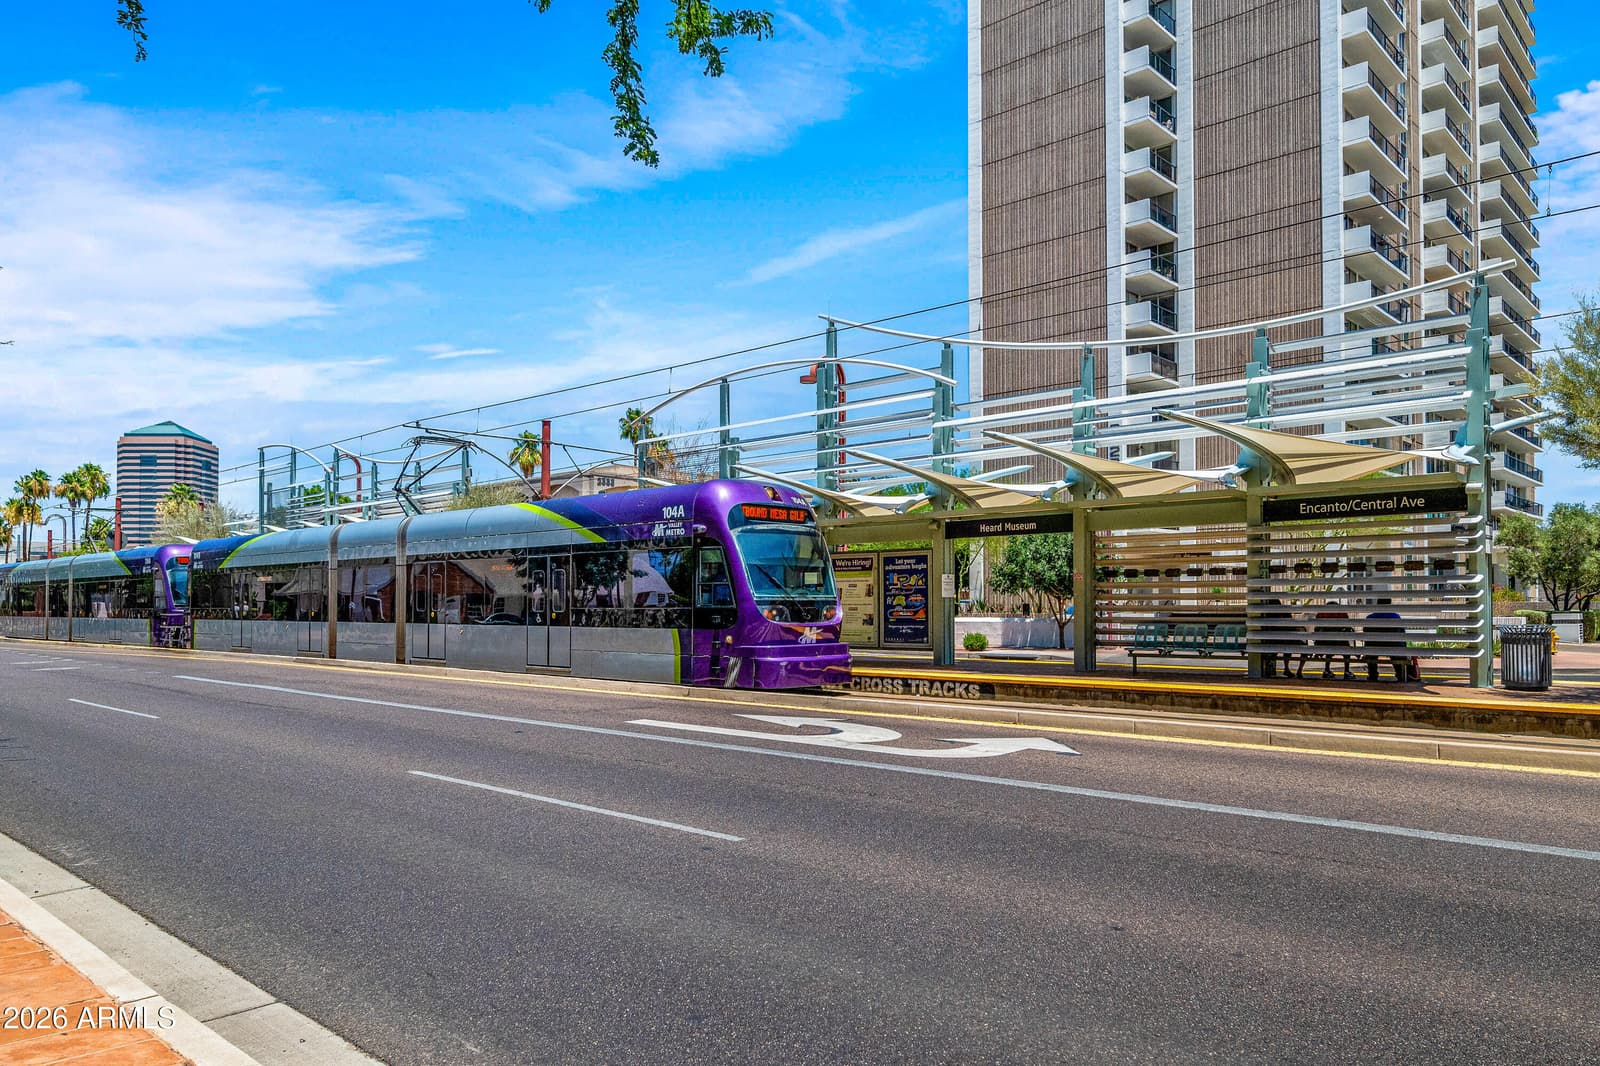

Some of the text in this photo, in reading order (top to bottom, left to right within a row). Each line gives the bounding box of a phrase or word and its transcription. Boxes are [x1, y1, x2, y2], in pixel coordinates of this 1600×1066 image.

[1300, 497, 1425, 514] Encanto/Central Ave
[662, 505, 685, 519] 104A
[666, 528, 685, 536] METRO
[980, 522, 1036, 532] Heard Museum
[852, 559, 872, 568] Hiring!
[851, 677, 980, 699] CROSS TRACKS
